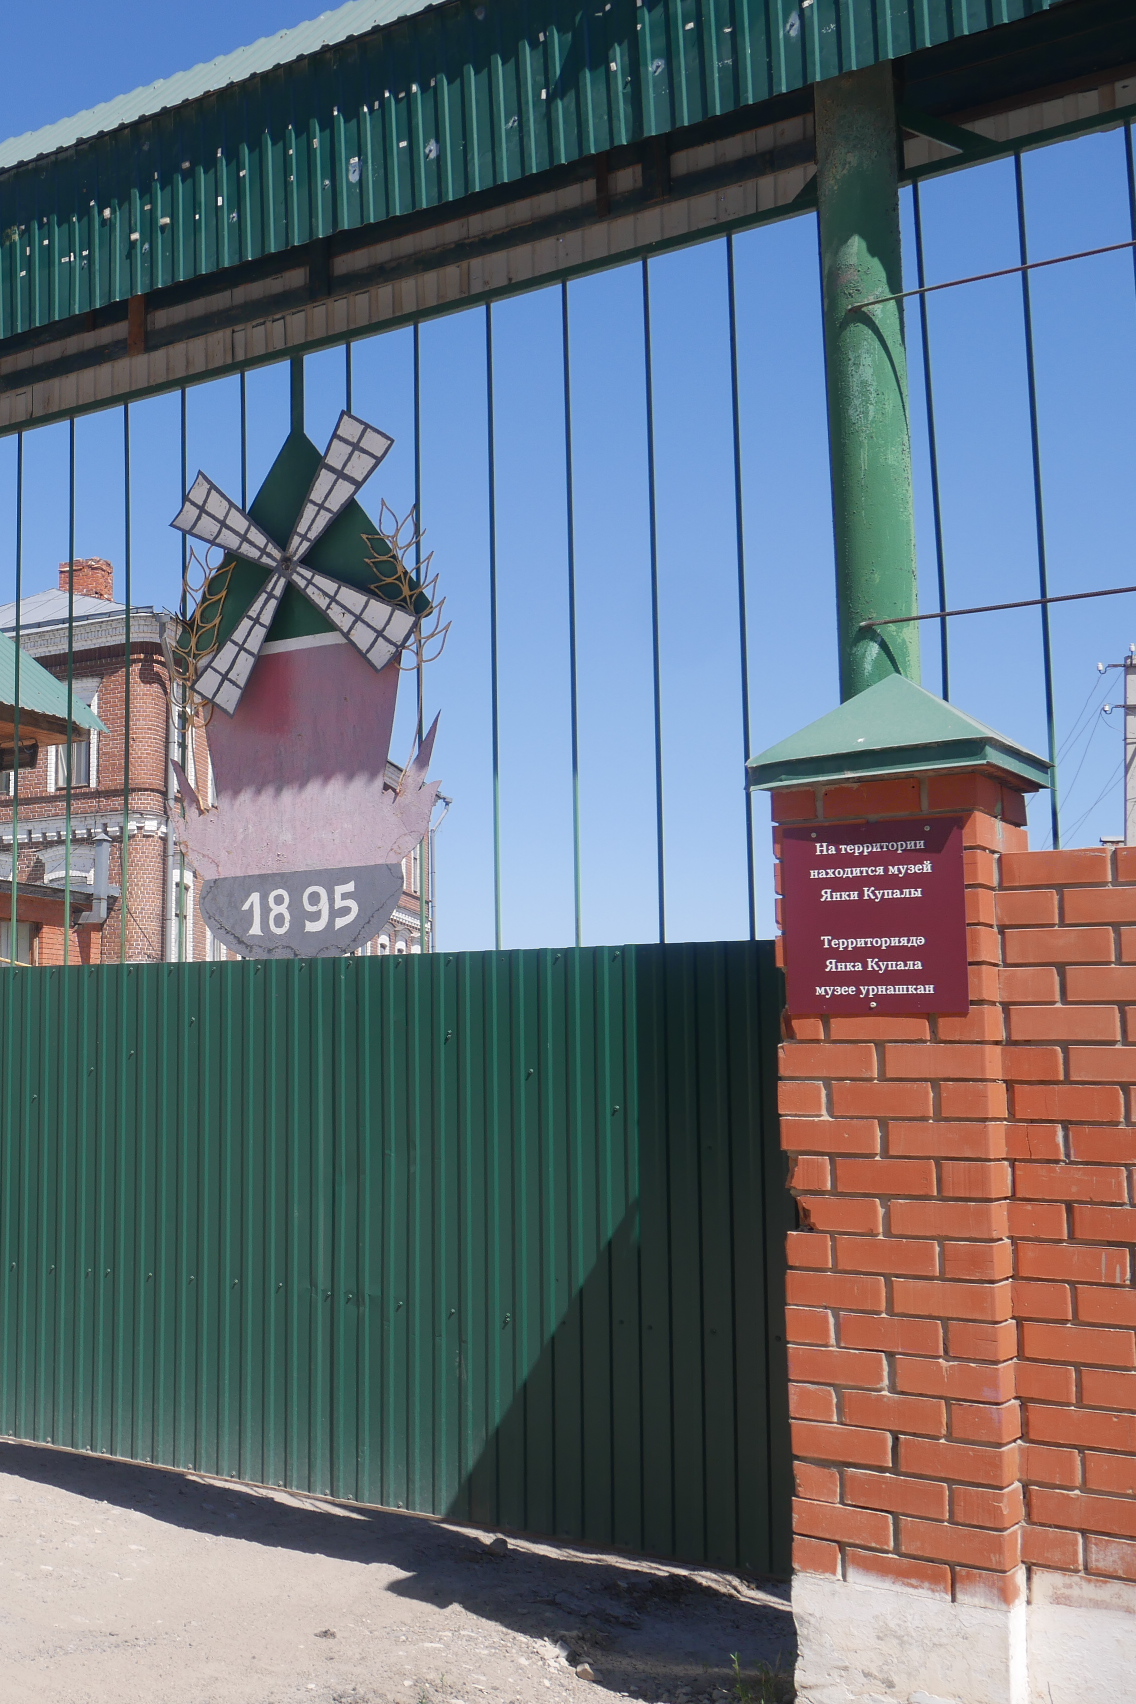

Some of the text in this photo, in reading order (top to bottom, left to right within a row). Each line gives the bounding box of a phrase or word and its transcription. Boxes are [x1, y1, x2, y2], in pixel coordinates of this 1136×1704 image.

[815, 840, 926, 856] На территории
[809, 860, 933, 879] находится музей
[820, 887, 922, 902] Янки Купалы
[241, 880, 359, 936] 1895
[820, 935, 925, 950] Территориядә
[824, 958, 923, 973] Янка Купала
[815, 983, 935, 998] музее урнашкан
